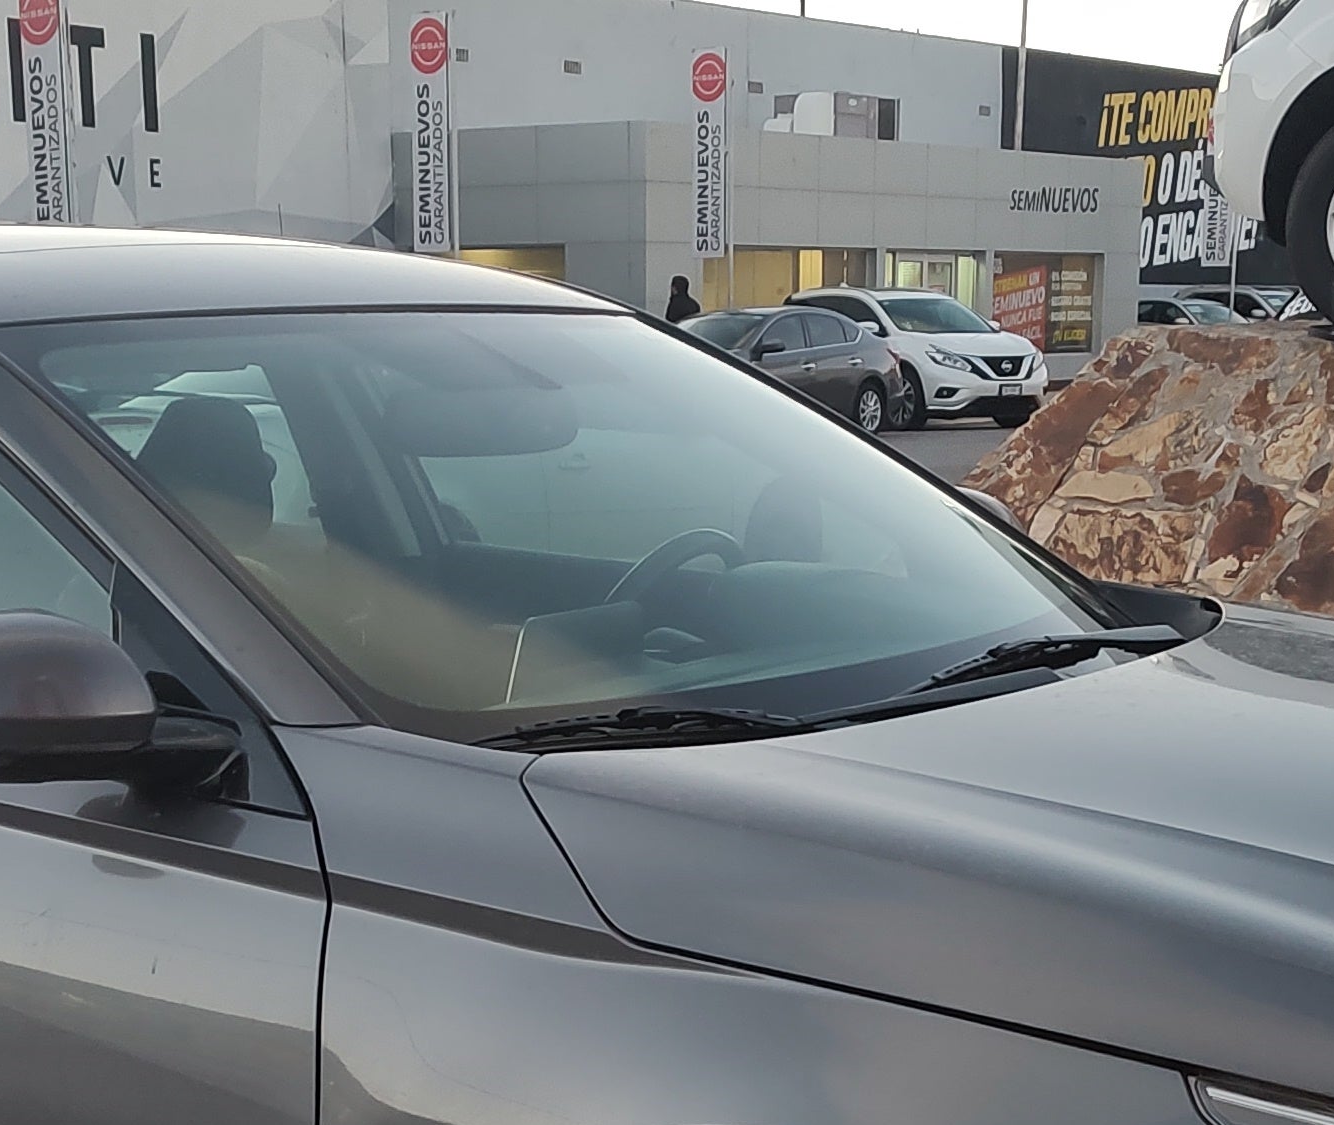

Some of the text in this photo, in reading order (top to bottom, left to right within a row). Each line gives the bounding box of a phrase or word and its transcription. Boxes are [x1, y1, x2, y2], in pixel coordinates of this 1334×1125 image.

[411, 41, 446, 51] NISSAN
[28, 56, 51, 222] EMINUEVOS
[45, 74, 65, 223] ARANTIZADOS
[417, 83, 432, 245] SEMINUEVOS
[432, 100, 445, 245] GARANTIZADOS
[696, 110, 710, 252] SEMINUEVOS
[1137, 88, 1213, 144] COMPR
[710, 124, 722, 252] GARANTIZADOS
[1009, 186, 1100, 213] SEMINUEVOS
[994, 286, 1046, 317] EMINUEVO
